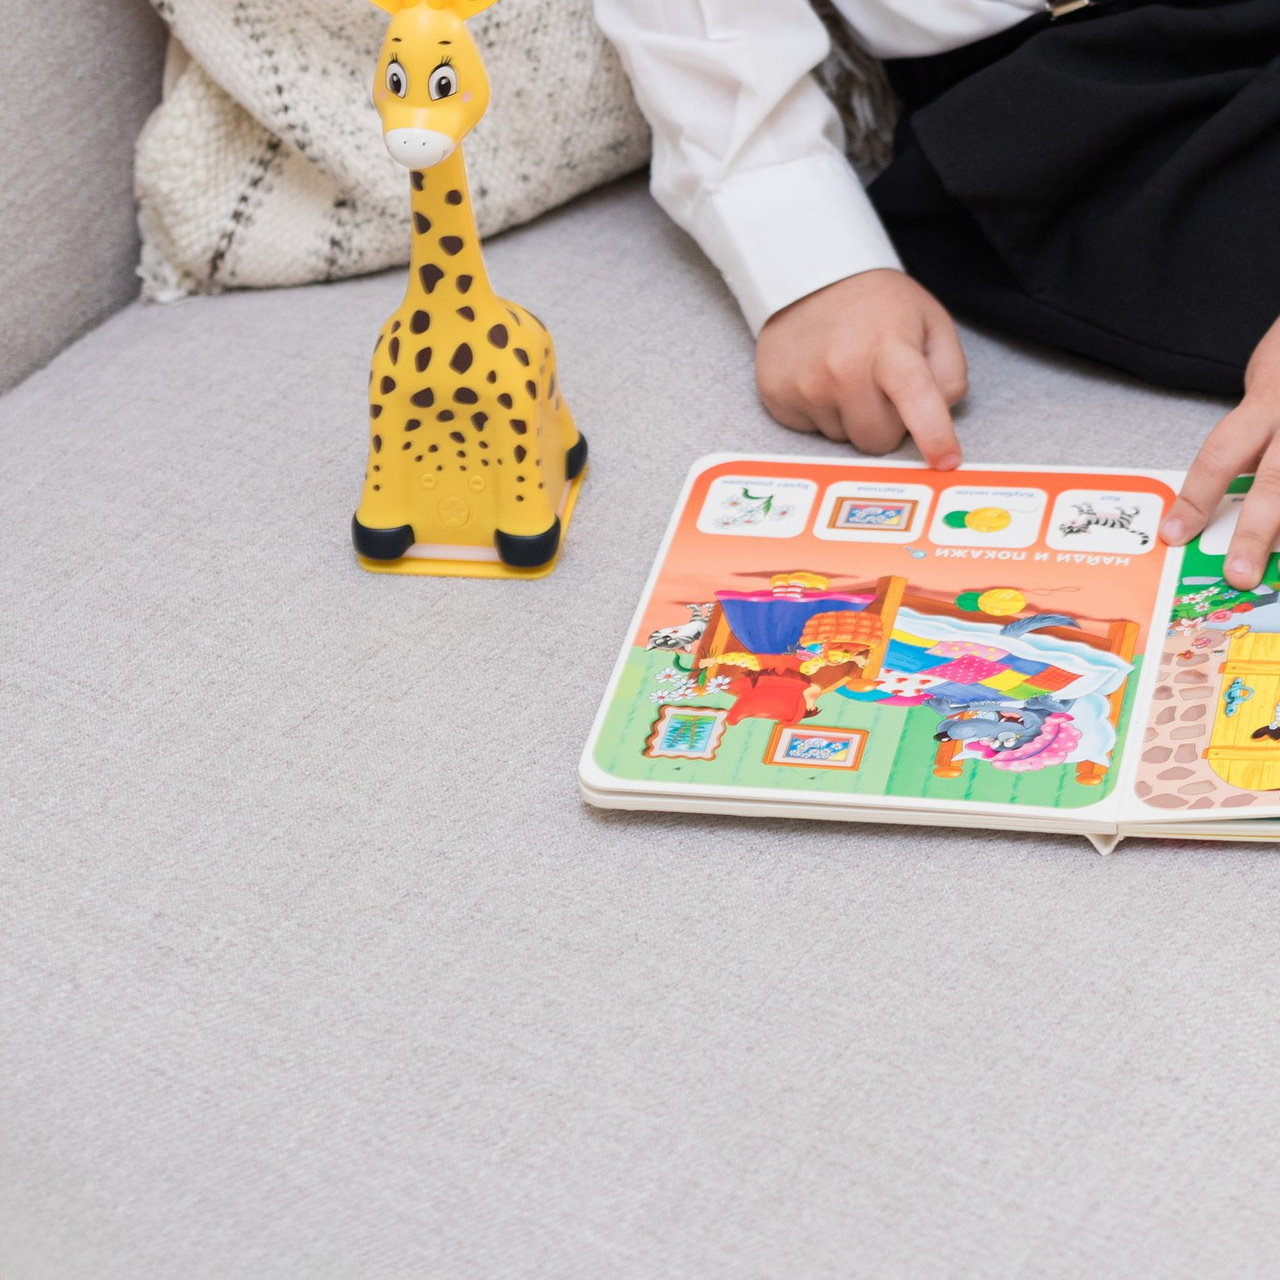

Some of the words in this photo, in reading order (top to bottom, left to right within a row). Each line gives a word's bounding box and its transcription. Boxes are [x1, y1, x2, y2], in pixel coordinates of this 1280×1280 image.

[935, 548, 1028, 561] ПОКАЖИ
[1034, 552, 1050, 562] И
[1056, 553, 1130, 567] НАЙДИ
